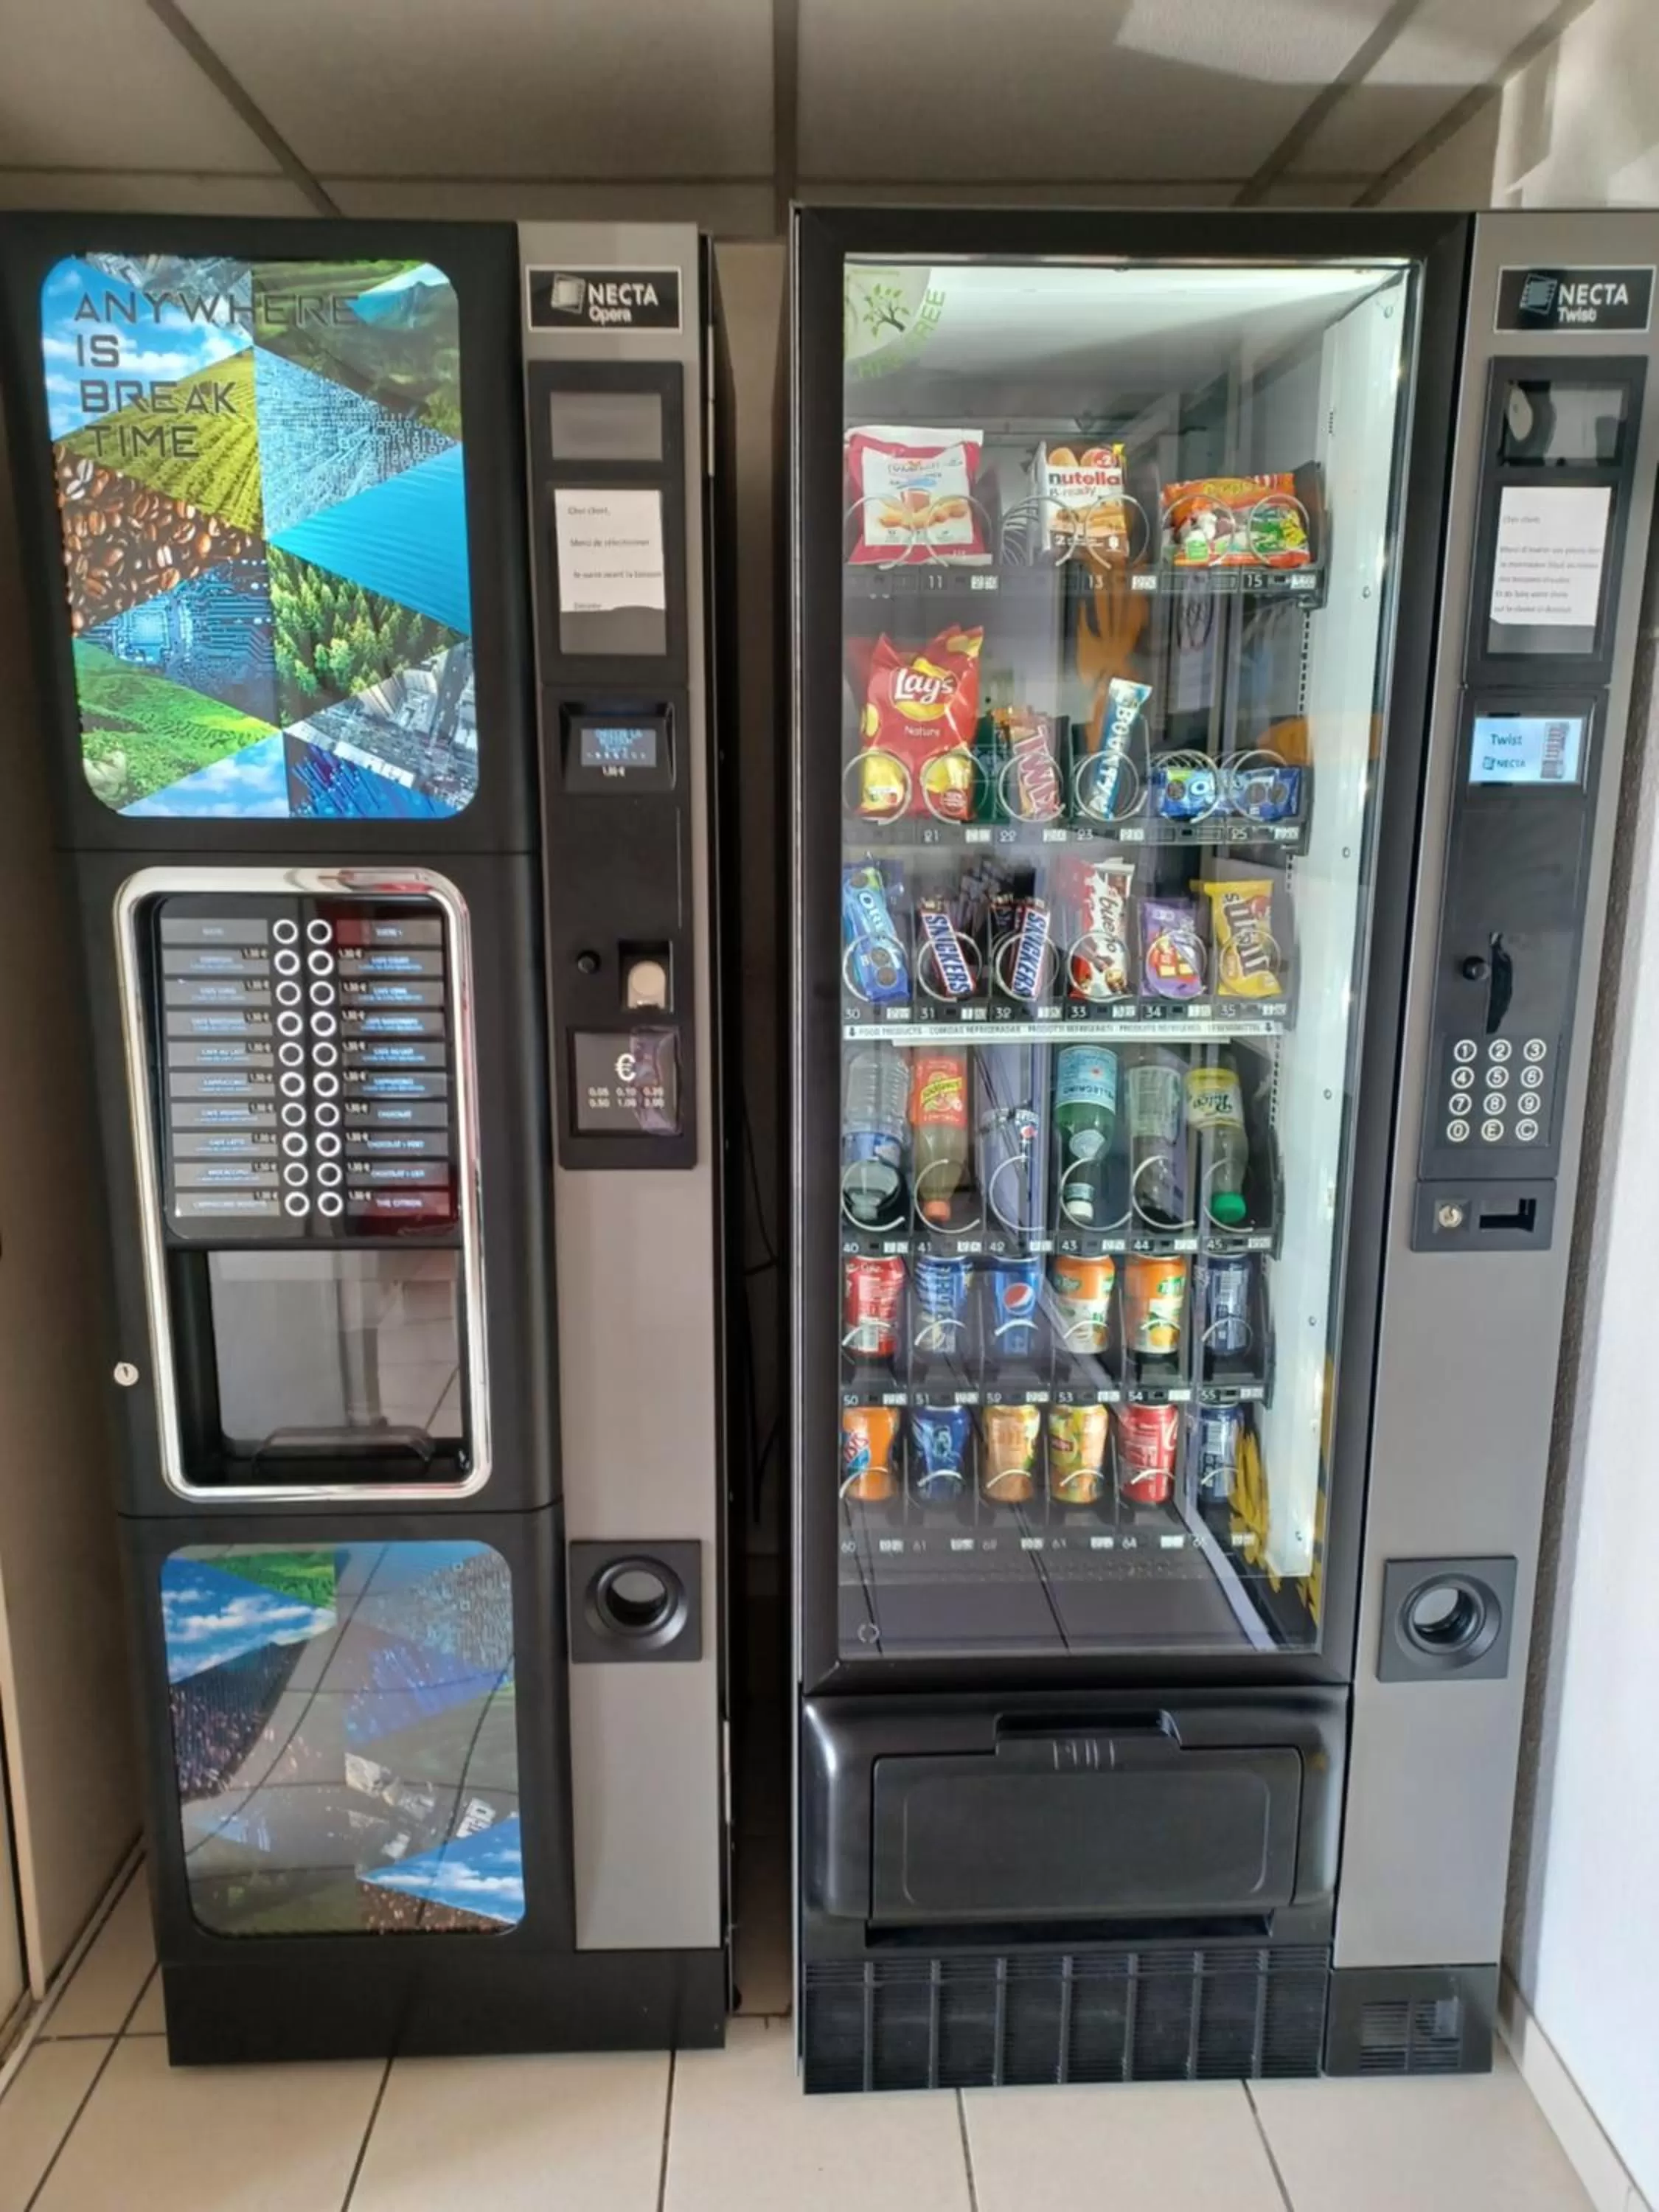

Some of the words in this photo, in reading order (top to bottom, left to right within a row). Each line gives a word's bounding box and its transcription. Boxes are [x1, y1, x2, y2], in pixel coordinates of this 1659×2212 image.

[589, 282, 659, 306] NECTA
[1558, 283, 1629, 305] NECTA
[73, 292, 361, 326] ANYWHERE
[1558, 307, 1597, 322] Twist
[589, 307, 633, 326] Opera
[77, 334, 120, 369] IS
[80, 380, 237, 414] BREAK
[83, 425, 201, 460] TIME
[928, 575, 942, 589] 11
[1089, 575, 1104, 589] 13
[1247, 574, 1263, 587] 15
[1491, 733, 1523, 746] Twist
[923, 914, 971, 994] SNICKERS
[1013, 912, 1046, 996] SNICKERS
[845, 1008, 861, 1020] 30
[921, 1007, 935, 1019] 31
[995, 1007, 1012, 1019] 32
[1070, 1006, 1087, 1018] 33
[1144, 1005, 1162, 1018] 34
[1221, 1005, 1237, 1017] 35
[1462, 1046, 1469, 1057] 1
[1496, 1045, 1505, 1057] 2
[1531, 1044, 1540, 1056] 3
[615, 1053, 637, 1082] €
[1457, 1072, 1466, 1083] 4
[1494, 1071, 1503, 1083] 5
[1528, 1071, 1536, 1082] 6
[1456, 1099, 1465, 1110] 7
[1490, 1098, 1499, 1110] 8
[1525, 1098, 1534, 1109] 9
[1453, 1124, 1463, 1136] 0
[1487, 1124, 1496, 1135] E
[1522, 1124, 1532, 1135] C
[843, 1242, 859, 1253] 40
[918, 1242, 931, 1253] 41
[1062, 1239, 1077, 1251] 43
[1134, 1239, 1150, 1251] 44
[1208, 1239, 1223, 1250] 45
[844, 1394, 859, 1405] 50
[1059, 1392, 1074, 1402] 53
[1128, 1391, 1143, 1402] 54
